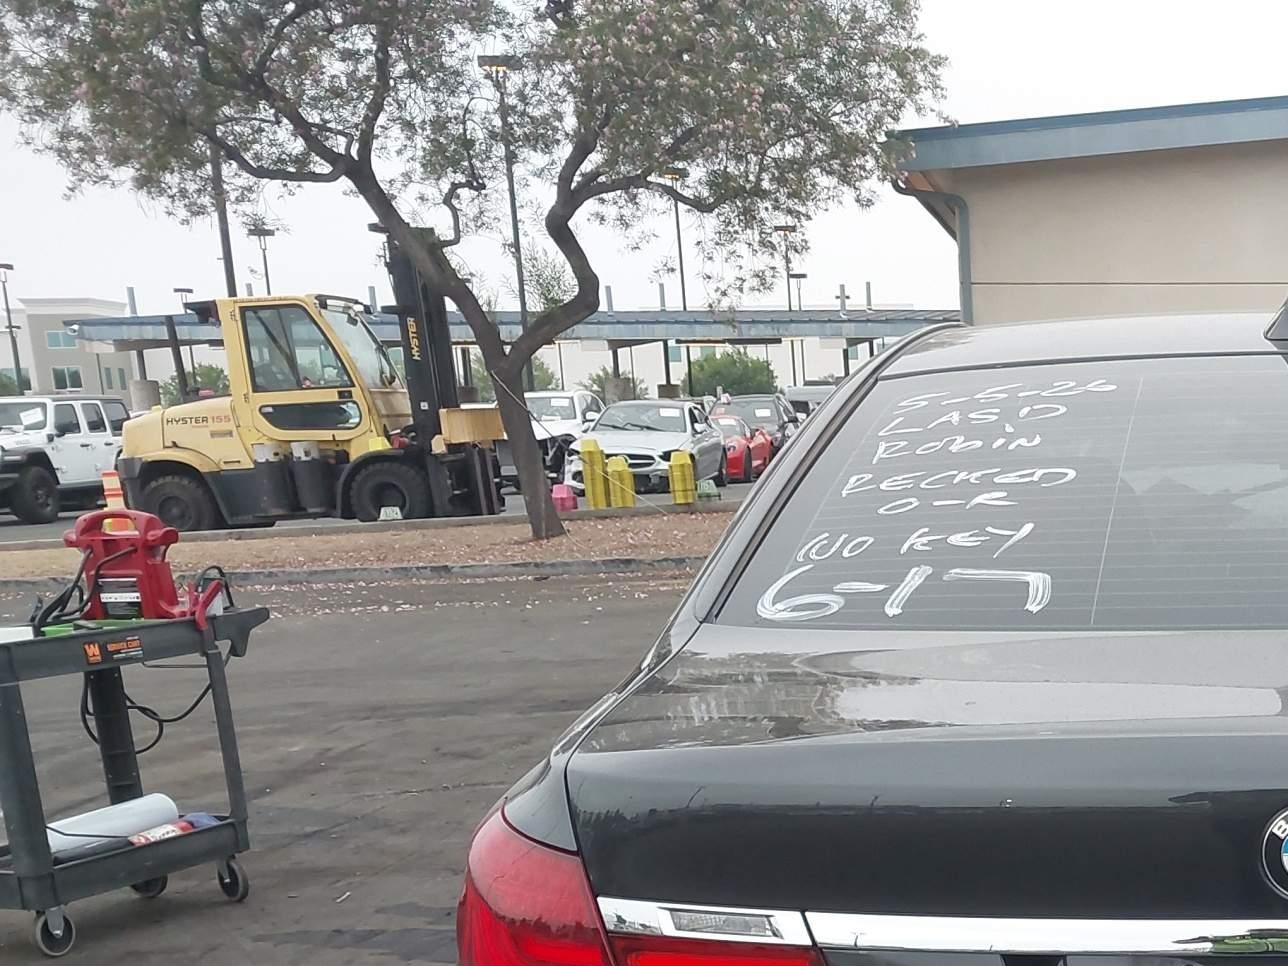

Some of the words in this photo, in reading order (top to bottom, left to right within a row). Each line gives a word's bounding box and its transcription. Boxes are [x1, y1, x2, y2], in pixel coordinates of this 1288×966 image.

[406, 316, 422, 361] HYSTER
[166, 415, 209, 426] HYSTER
[211, 414, 232, 424] 155
[900, 522, 1035, 559] KEY
[756, 564, 1051, 621] 6-17
